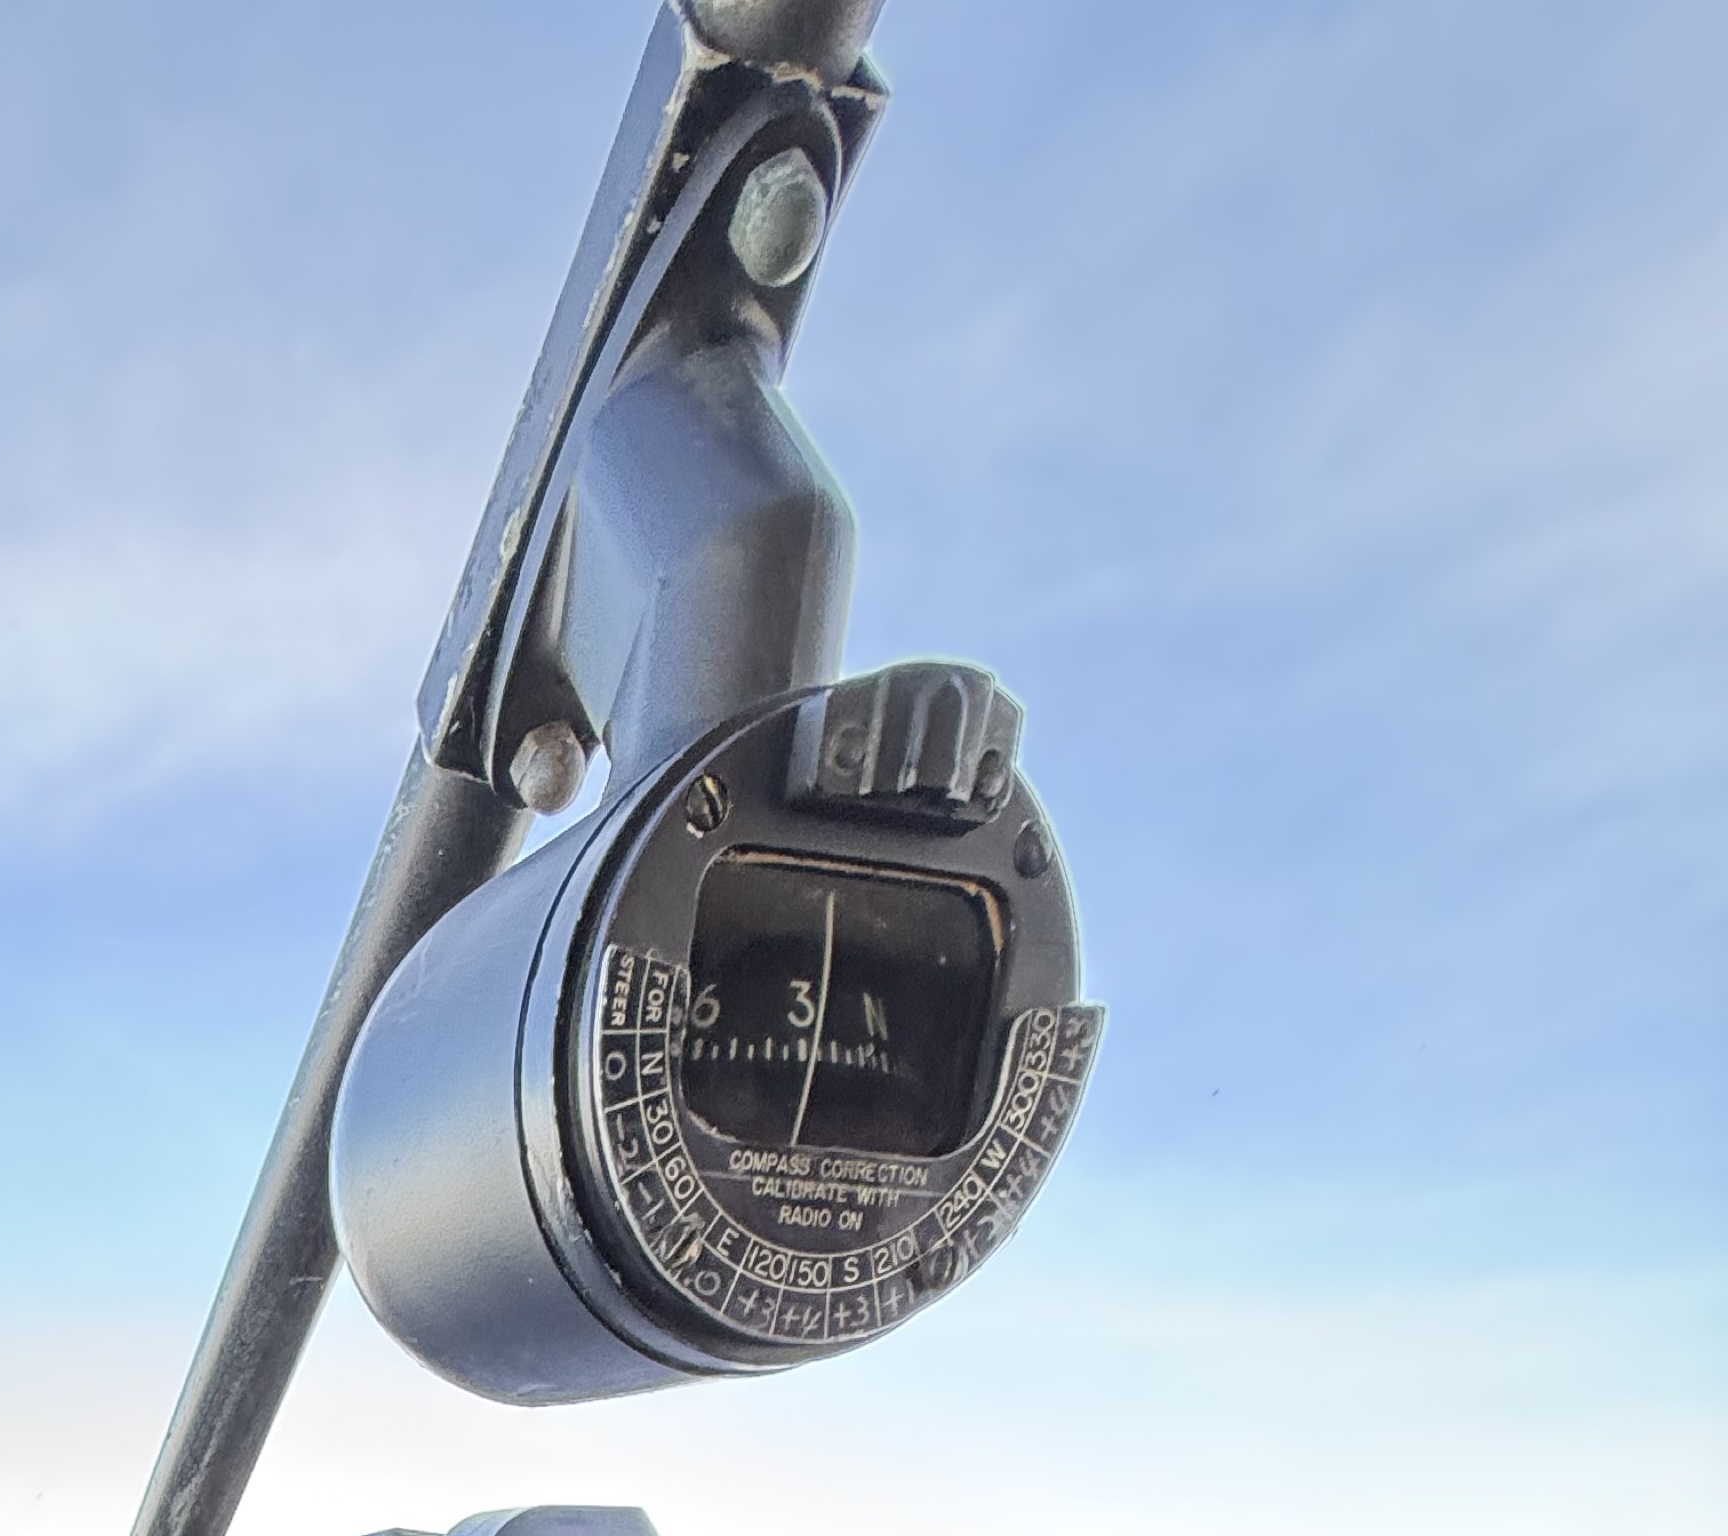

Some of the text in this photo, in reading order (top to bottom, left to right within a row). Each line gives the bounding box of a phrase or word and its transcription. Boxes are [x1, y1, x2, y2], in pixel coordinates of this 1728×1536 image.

[646, 972, 669, 1023] FOR
[788, 981, 814, 1025] 3
[642, 1051, 665, 1074] N
[646, 1106, 671, 1144] 30
[730, 1150, 928, 1183] COMPASS CORRECTION
[982, 1146, 1006, 1171] W
[666, 1156, 691, 1198] 60
[779, 1206, 862, 1229] RADIO ON
[716, 1231, 736, 1254] E
[878, 1237, 913, 1274] 210
[750, 1247, 784, 1279] 120
[789, 1260, 827, 1286] 150
[843, 1257, 858, 1281] S
